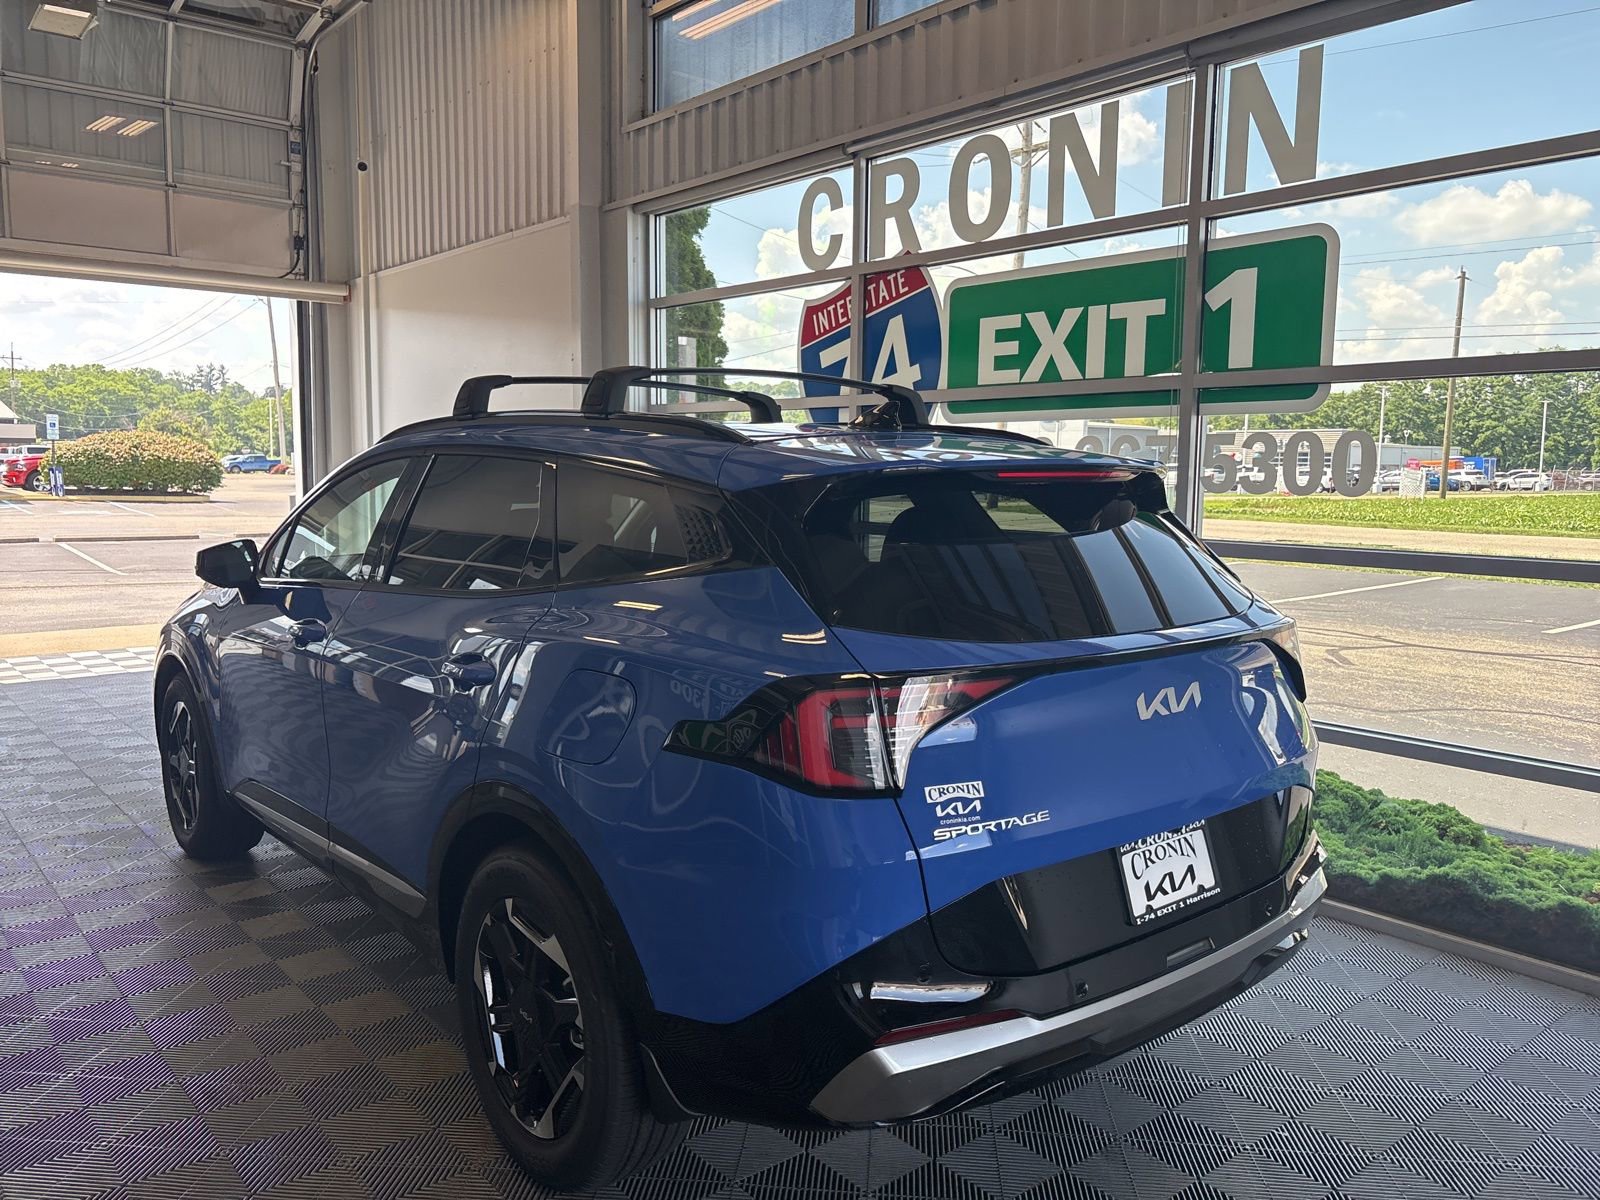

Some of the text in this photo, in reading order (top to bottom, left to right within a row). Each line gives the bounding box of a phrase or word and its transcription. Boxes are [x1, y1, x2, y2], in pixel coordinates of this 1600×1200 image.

[798, 44, 1324, 272] CRONIN
[812, 269, 909, 336] INTETATE
[977, 267, 1259, 386] EXIT 1
[1136, 681, 1203, 721] KIA
[927, 782, 982, 803] CRONIN
[935, 799, 982, 818] KIA
[933, 810, 1051, 841] SPORTAGE
[940, 815, 981, 826] croninkia.com
[1131, 834, 1198, 881] CRONIN
[1143, 863, 1197, 902] KIA
[1135, 911, 1156, 926] I-74
[1156, 902, 1178, 917] EXIT
[1186, 887, 1221, 906] Harrison
